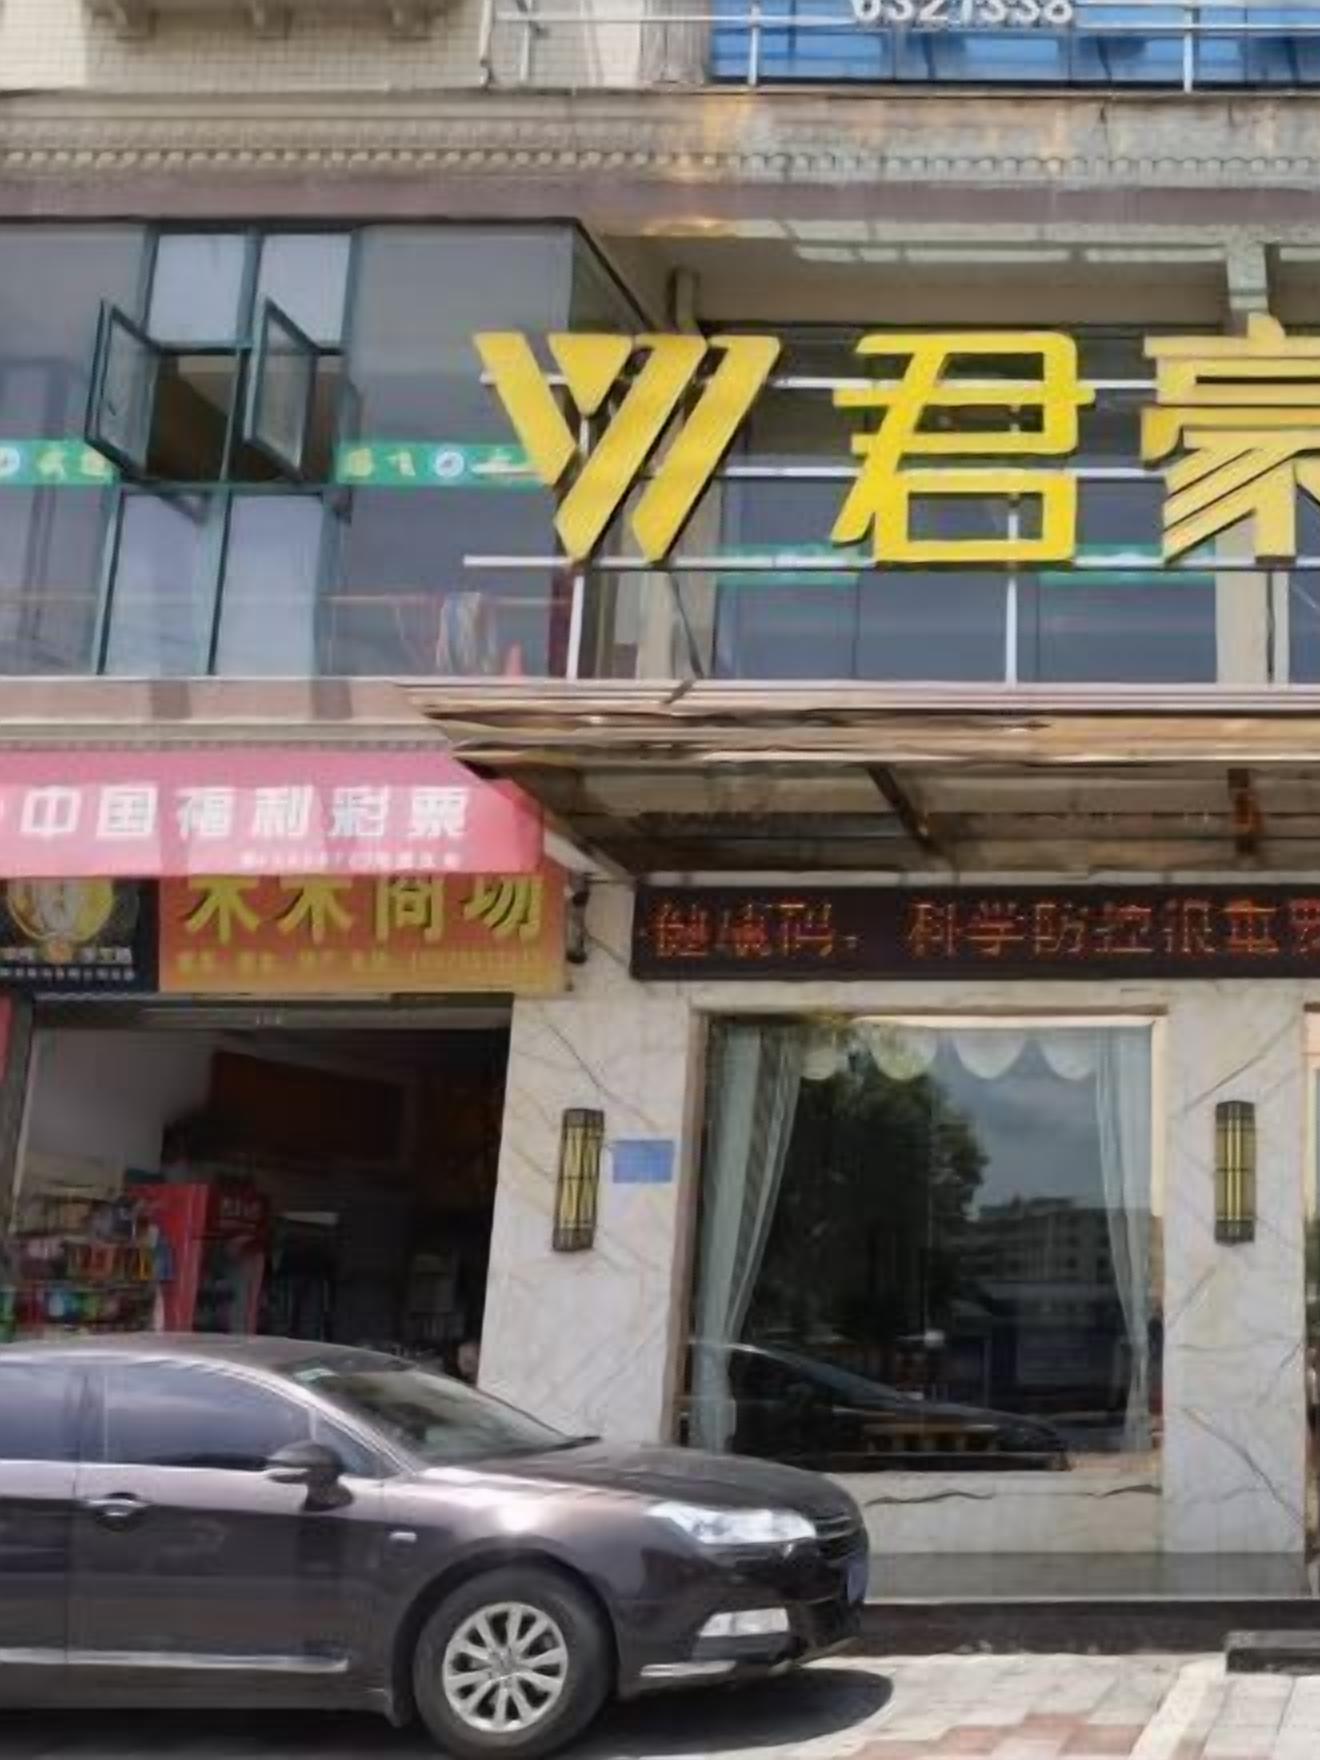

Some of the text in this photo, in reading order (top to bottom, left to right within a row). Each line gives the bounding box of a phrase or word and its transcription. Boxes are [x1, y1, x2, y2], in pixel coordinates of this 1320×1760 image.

[20, 785, 470, 841] 中国福利彩票
